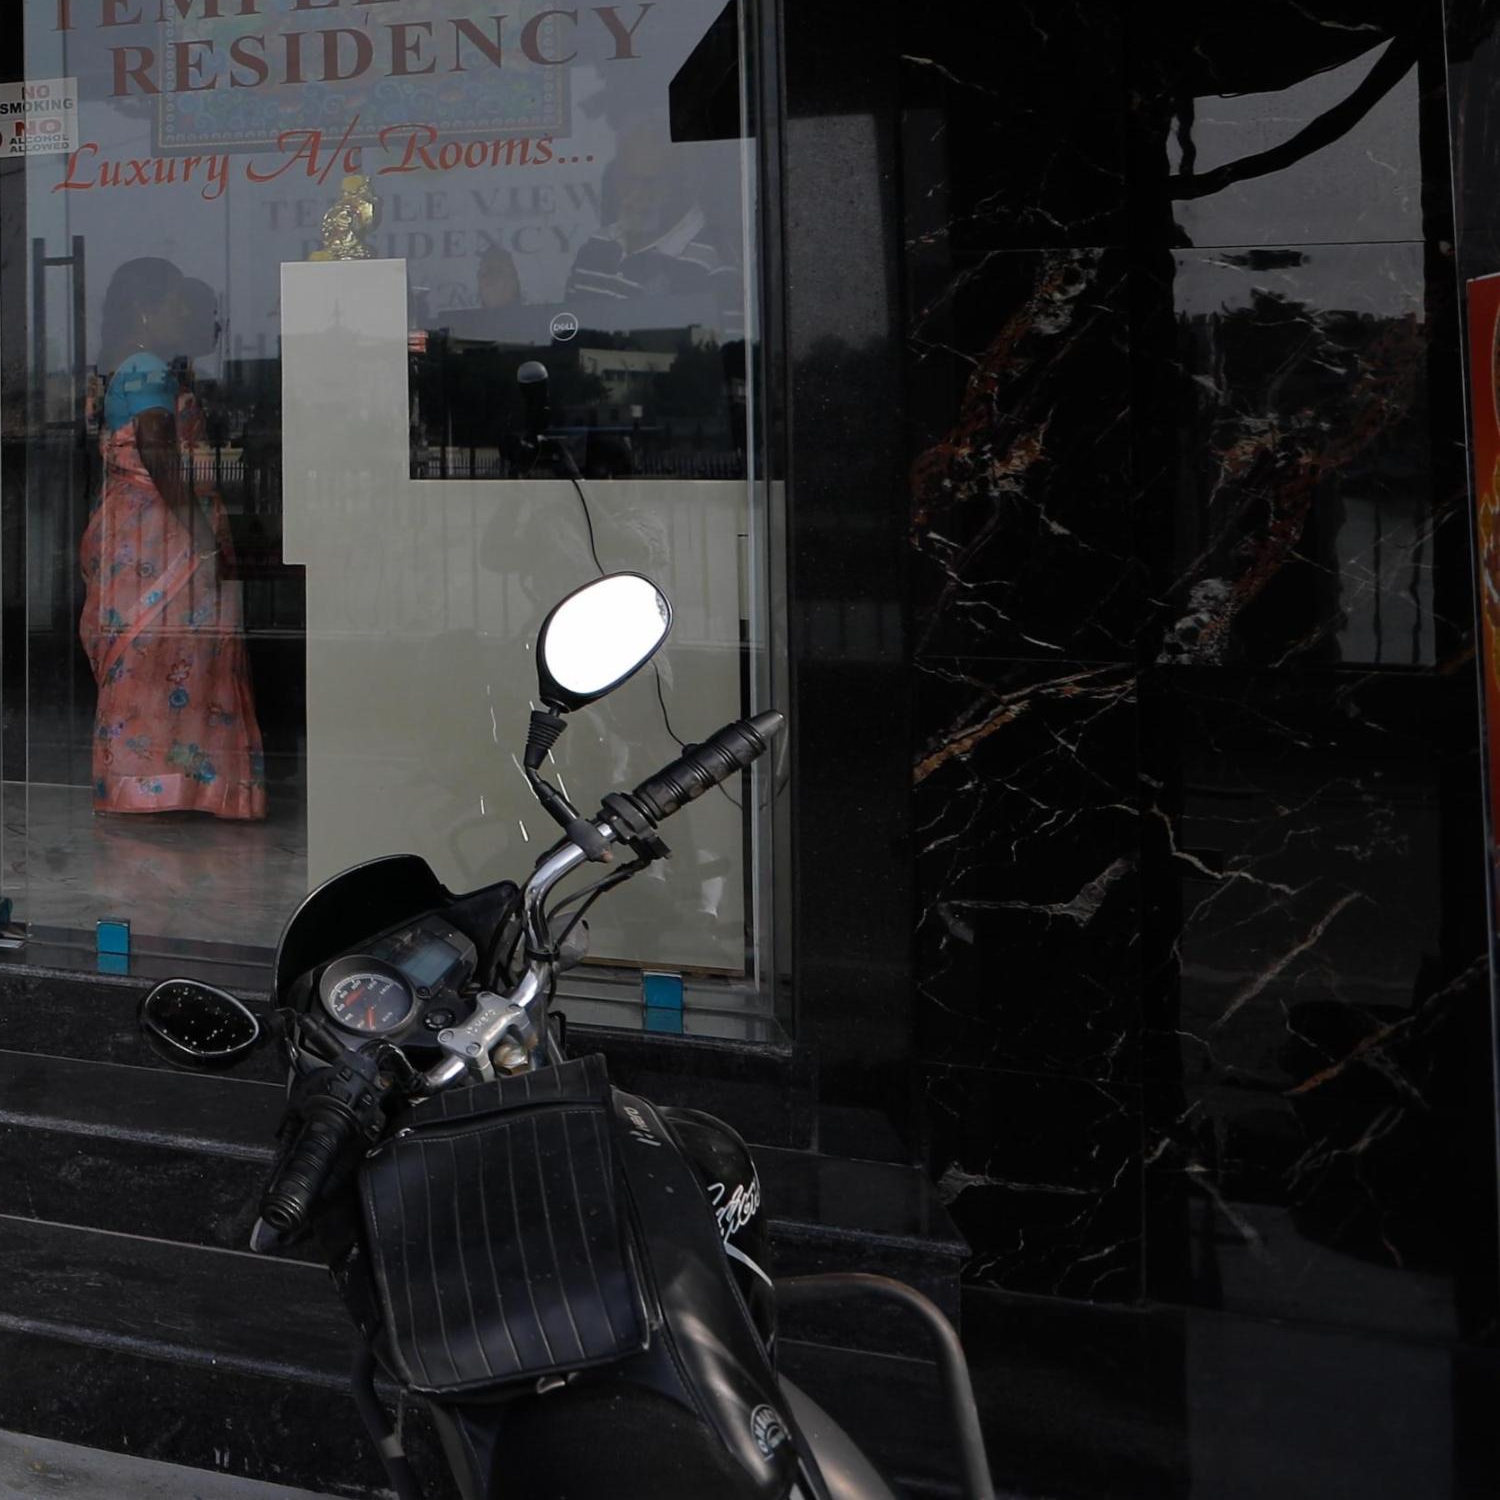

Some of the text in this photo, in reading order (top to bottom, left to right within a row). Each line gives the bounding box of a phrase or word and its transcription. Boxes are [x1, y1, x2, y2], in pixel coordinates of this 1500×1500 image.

[107, 2, 658, 98] RESIDENCY
[21, 85, 50, 100] NO
[0, 98, 73, 114] SMOKING
[14, 119, 62, 136] NO
[9, 133, 69, 145] ALCOHOL
[9, 142, 70, 153] ALLOWED
[51, 142, 232, 200] Luxury
[553, 322, 576, 332] DELL
